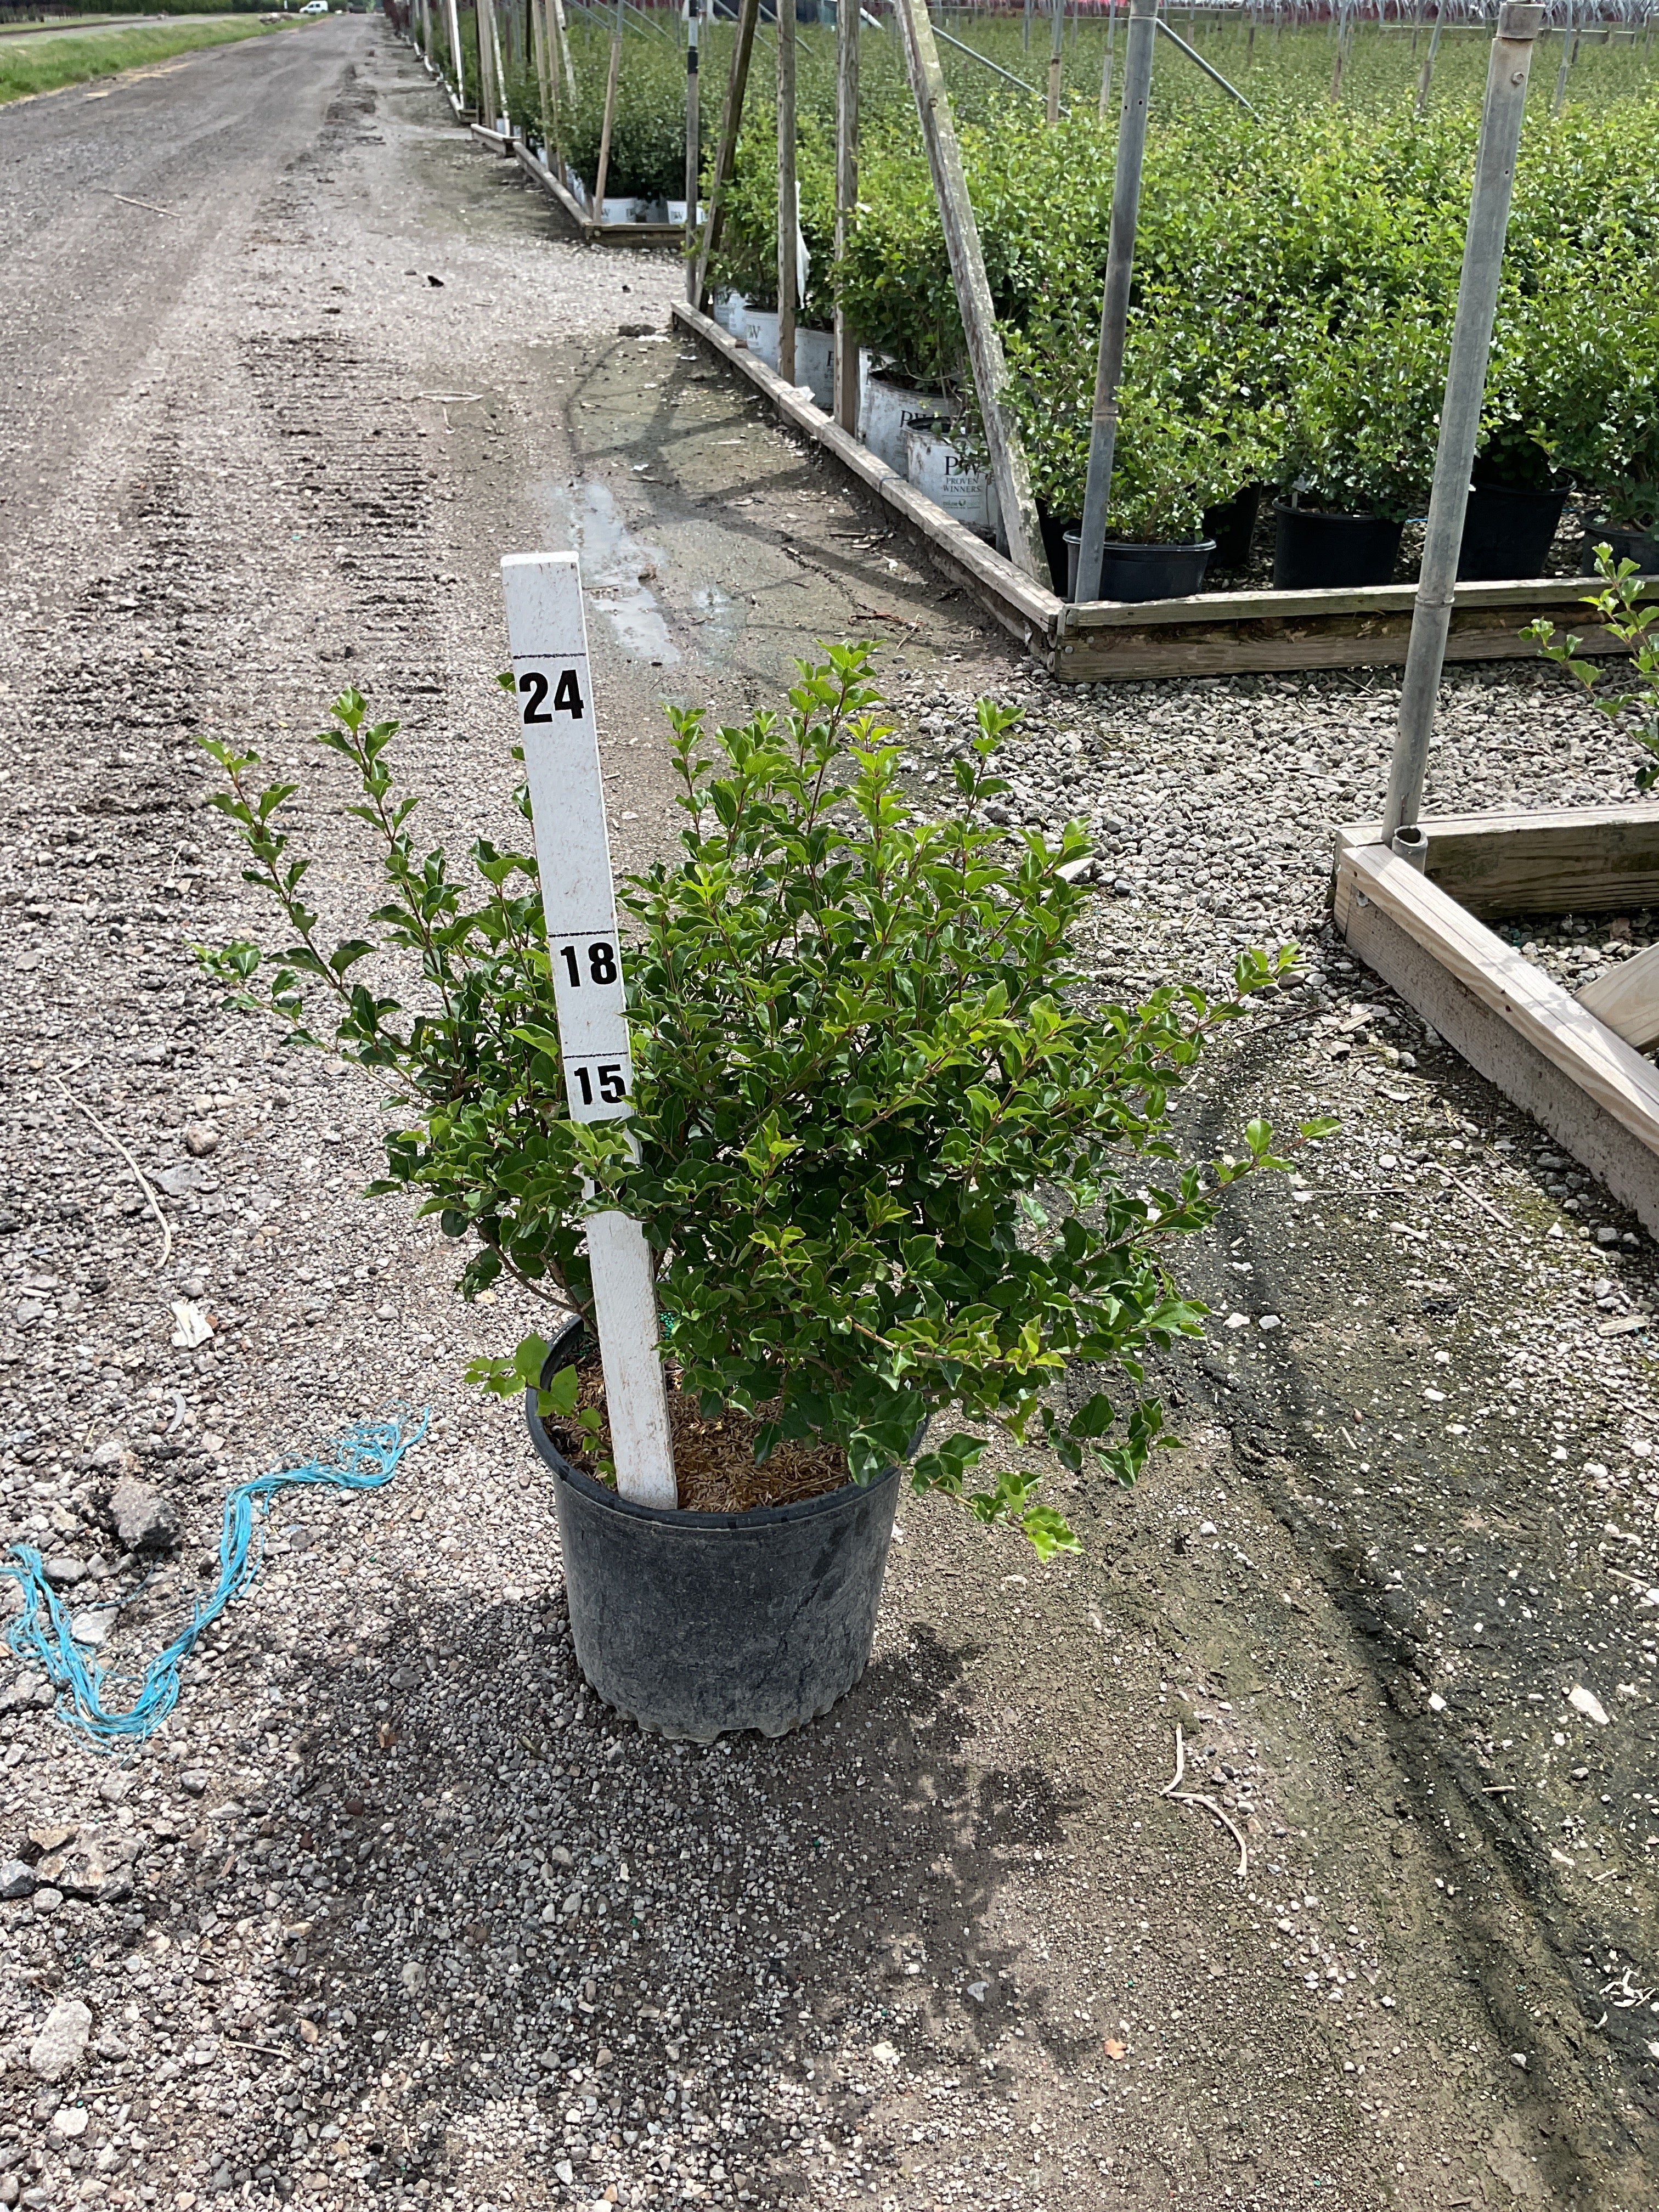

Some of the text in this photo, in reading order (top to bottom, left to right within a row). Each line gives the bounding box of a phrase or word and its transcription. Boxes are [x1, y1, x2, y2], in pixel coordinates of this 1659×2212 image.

[519, 669, 584, 724] 24
[560, 942, 617, 988] 18
[574, 1064, 627, 1105] 15
